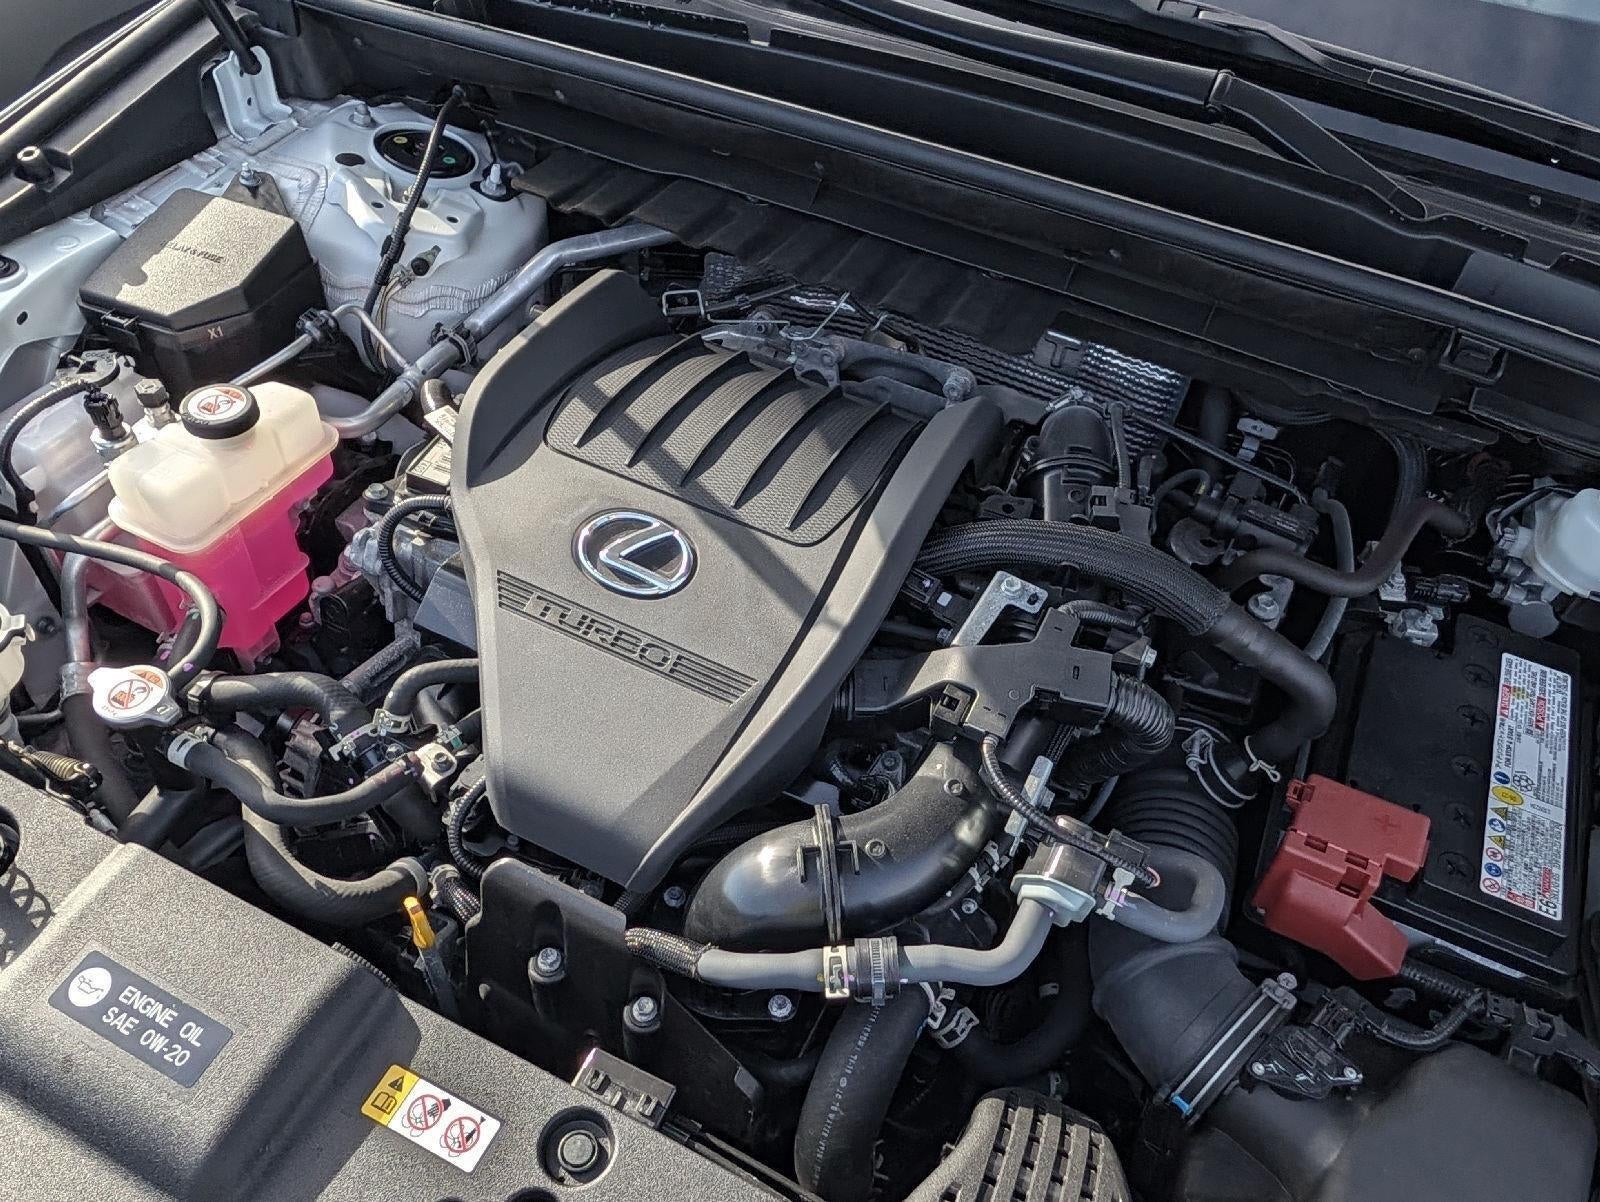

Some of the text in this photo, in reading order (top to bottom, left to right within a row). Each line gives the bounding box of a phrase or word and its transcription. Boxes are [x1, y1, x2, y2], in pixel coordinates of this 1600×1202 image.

[207, 326, 223, 340] X1
[536, 594, 672, 668] TURBO
[1539, 900, 1557, 917] E6
[102, 1006, 190, 1067] SAE 0W-20
[118, 985, 205, 1047] ENGINE OIL
